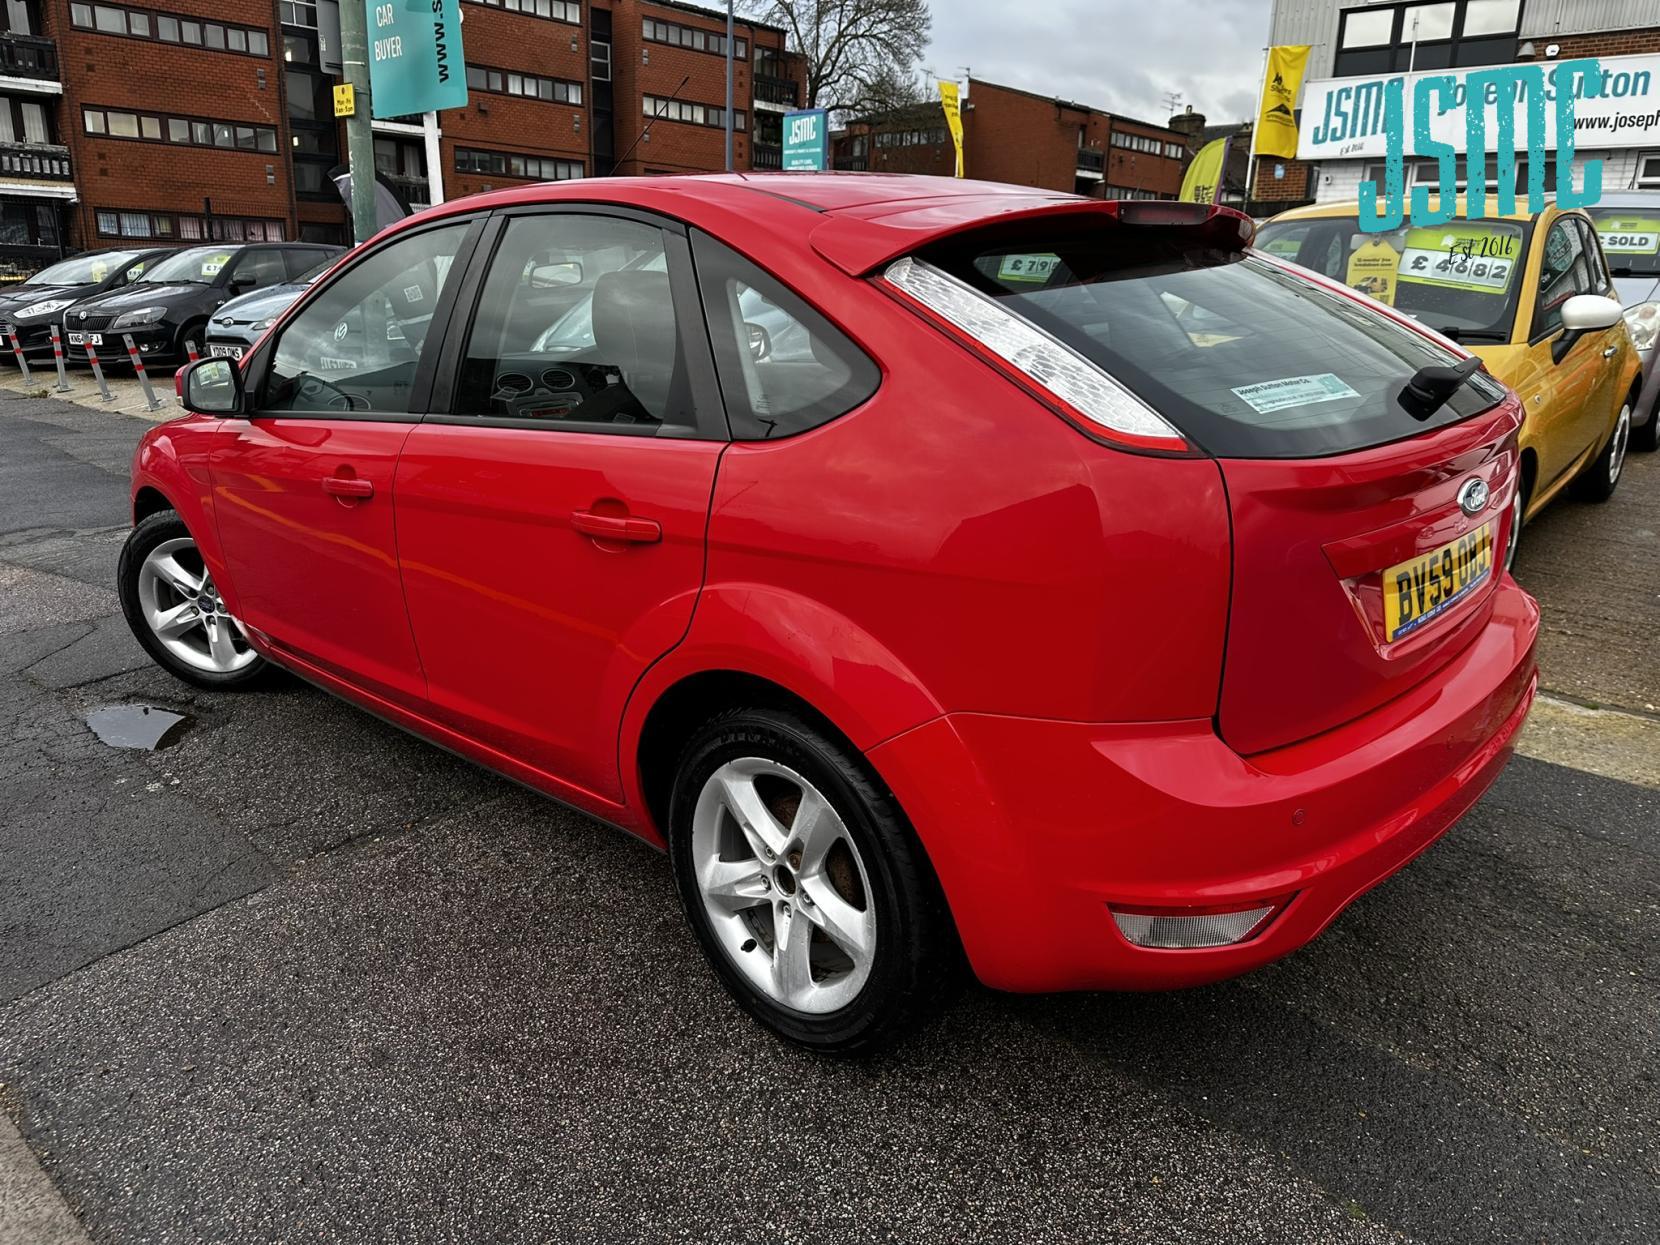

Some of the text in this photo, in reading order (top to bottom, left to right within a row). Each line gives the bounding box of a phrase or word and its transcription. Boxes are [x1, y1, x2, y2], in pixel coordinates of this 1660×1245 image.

[376, 3, 394, 27] CAR
[374, 36, 403, 61] BUYER
[788, 115, 816, 145] JSMC
[1607, 235, 1649, 247] SOLD
[1435, 257, 1508, 280] 4682
[1396, 548, 1454, 625] BV59
